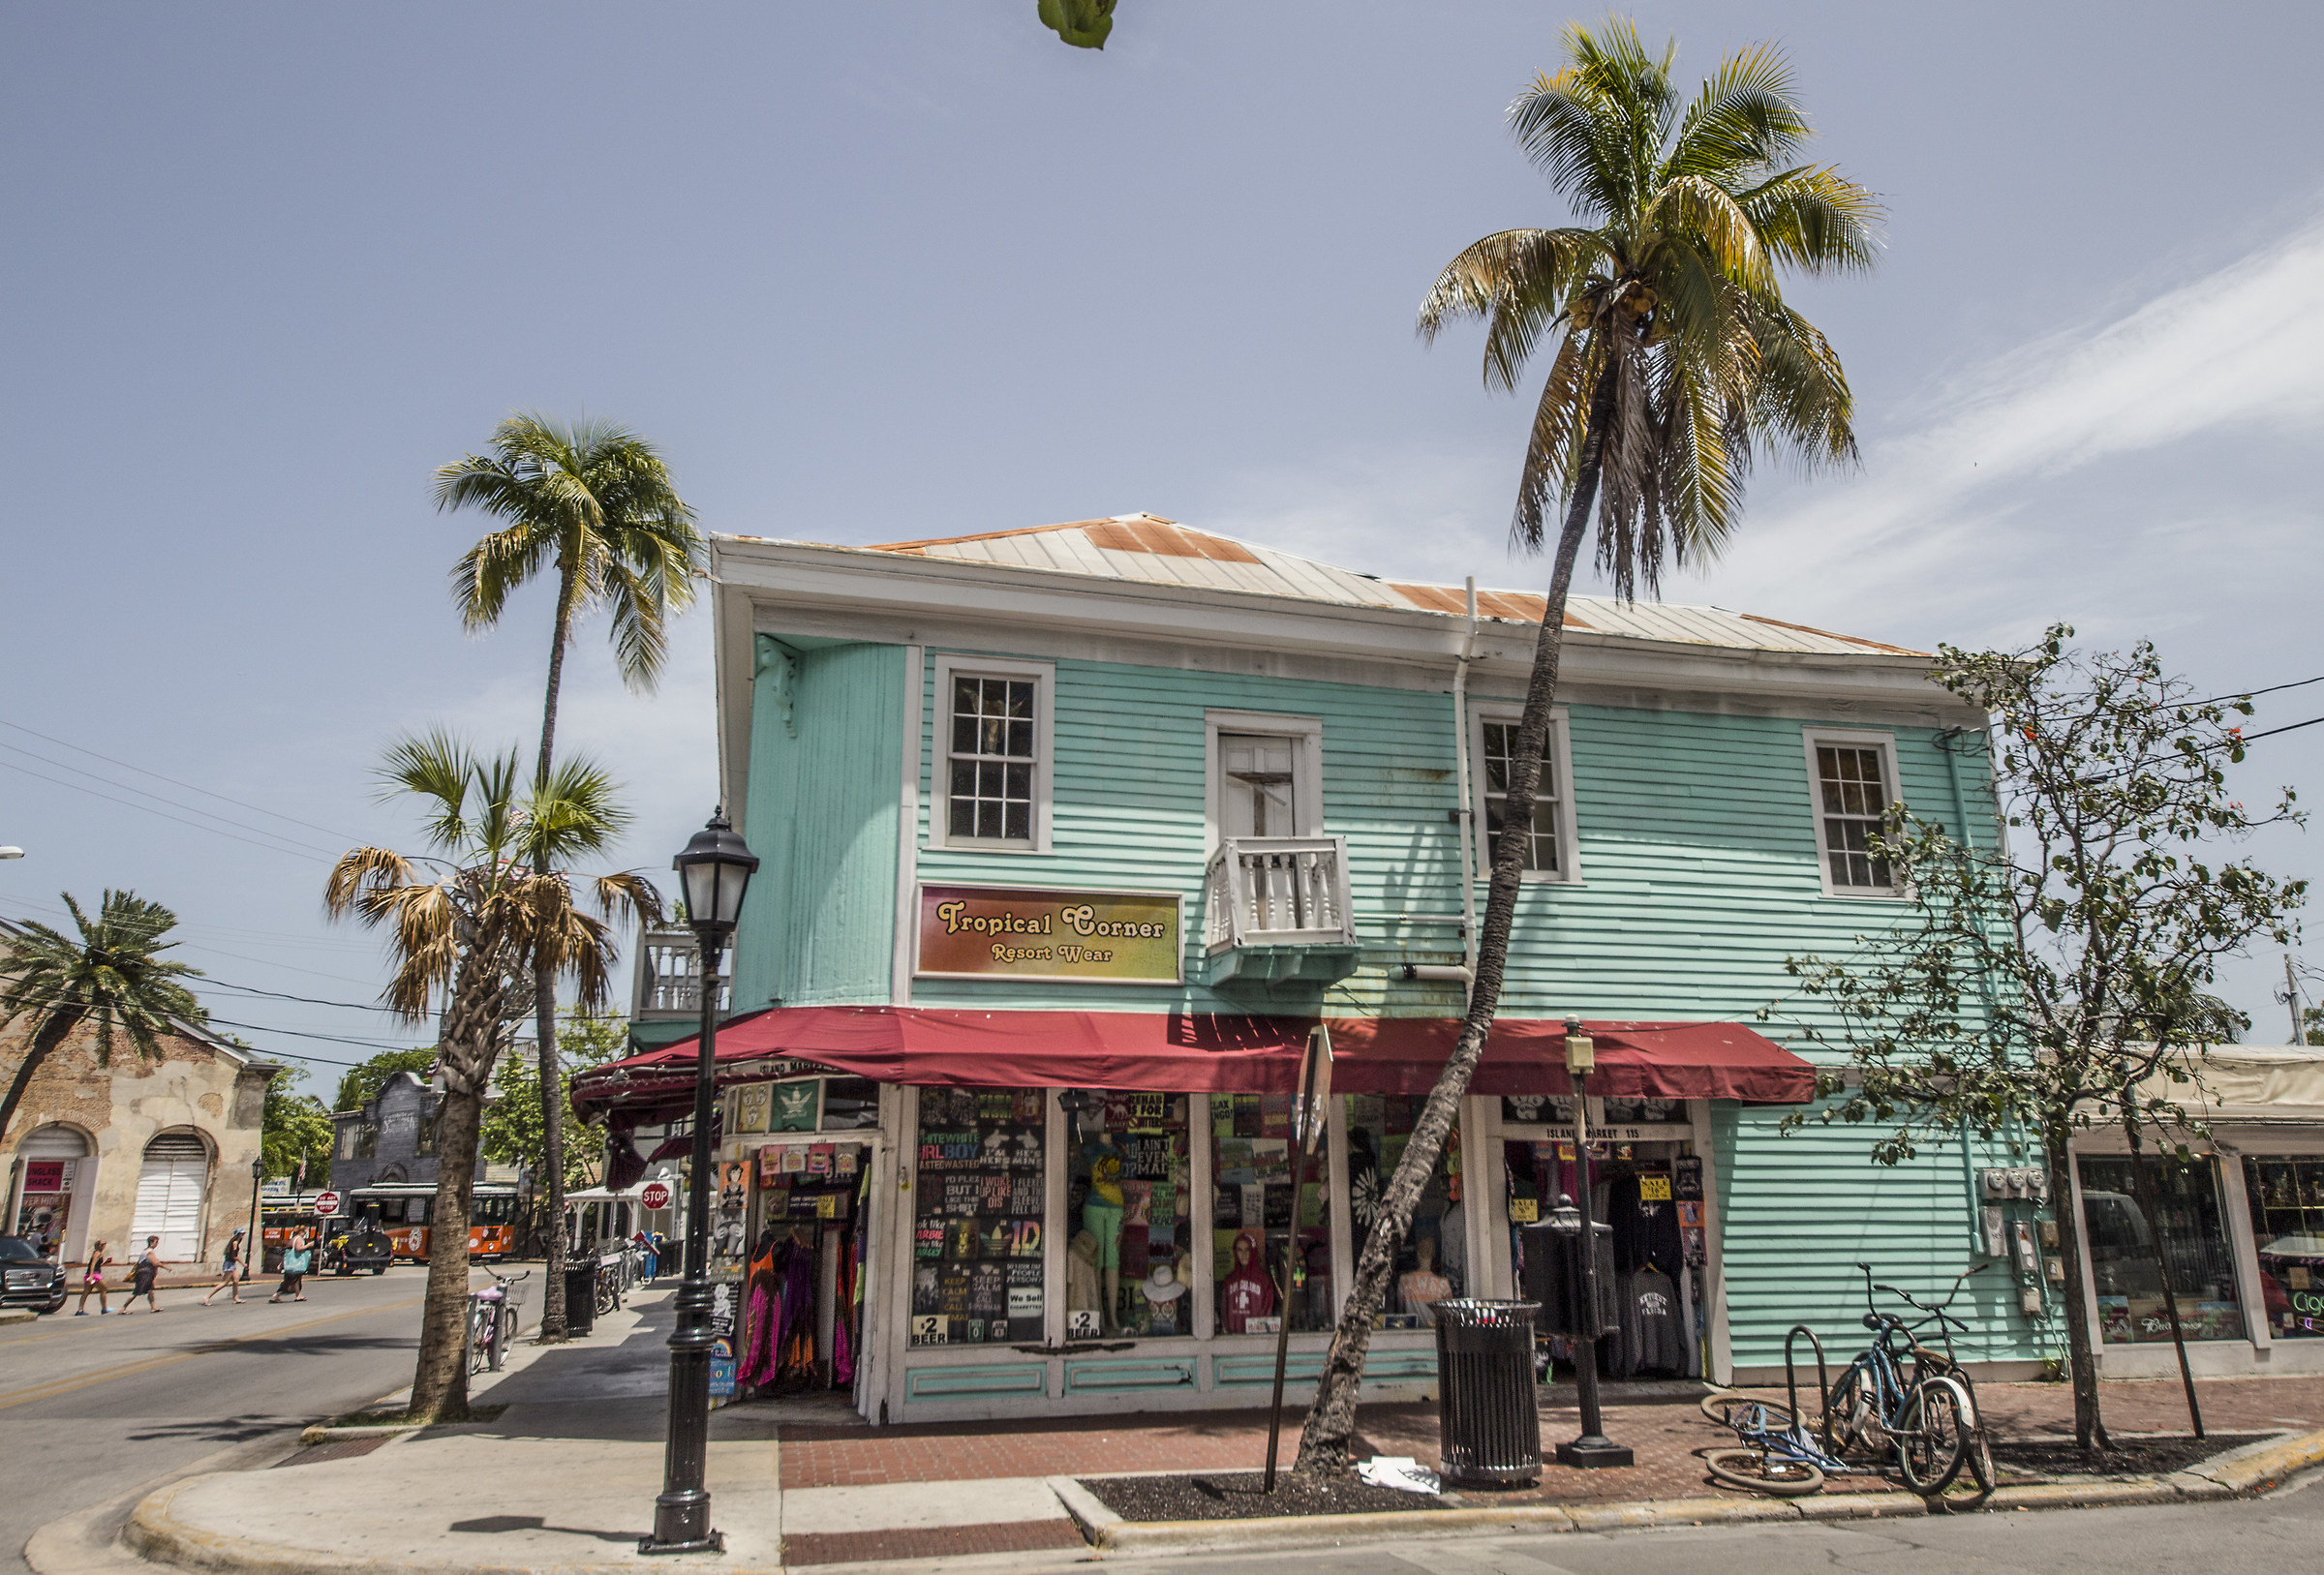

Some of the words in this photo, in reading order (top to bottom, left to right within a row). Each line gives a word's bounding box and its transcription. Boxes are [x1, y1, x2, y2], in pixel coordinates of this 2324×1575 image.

[936, 901, 1052, 937] Tropical
[1061, 904, 1165, 939] Corner
[992, 943, 1053, 963] Resort
[1057, 945, 1113, 963] Wear
[759, 1063, 785, 1074] ISLAND
[1141, 1105, 1162, 1115] FOR
[919, 1133, 945, 1144] HITE
[945, 1133, 980, 1144] WHITE
[1546, 1129, 1575, 1139] ISLAN
[1626, 1129, 1639, 1139] 115
[944, 1143, 980, 1160] BOY
[1137, 1151, 1169, 1163] EVEN
[919, 1159, 944, 1170] ASTED
[27, 1167, 61, 1176] UNGLASS
[986, 1175, 1011, 1187] WOKE
[946, 1184, 972, 1196] BUT
[979, 1186, 992, 1198] UP
[991, 1186, 1012, 1198] LIKE
[41, 1196, 60, 1205] HIDE
[643, 1191, 668, 1202] STOP
[988, 1196, 1004, 1209] DIS
[915, 1229, 944, 1240] ARBIE
[944, 1277, 965, 1286] KEEP
[942, 1287, 967, 1296] CALM
[912, 1333, 946, 1345] BEER
